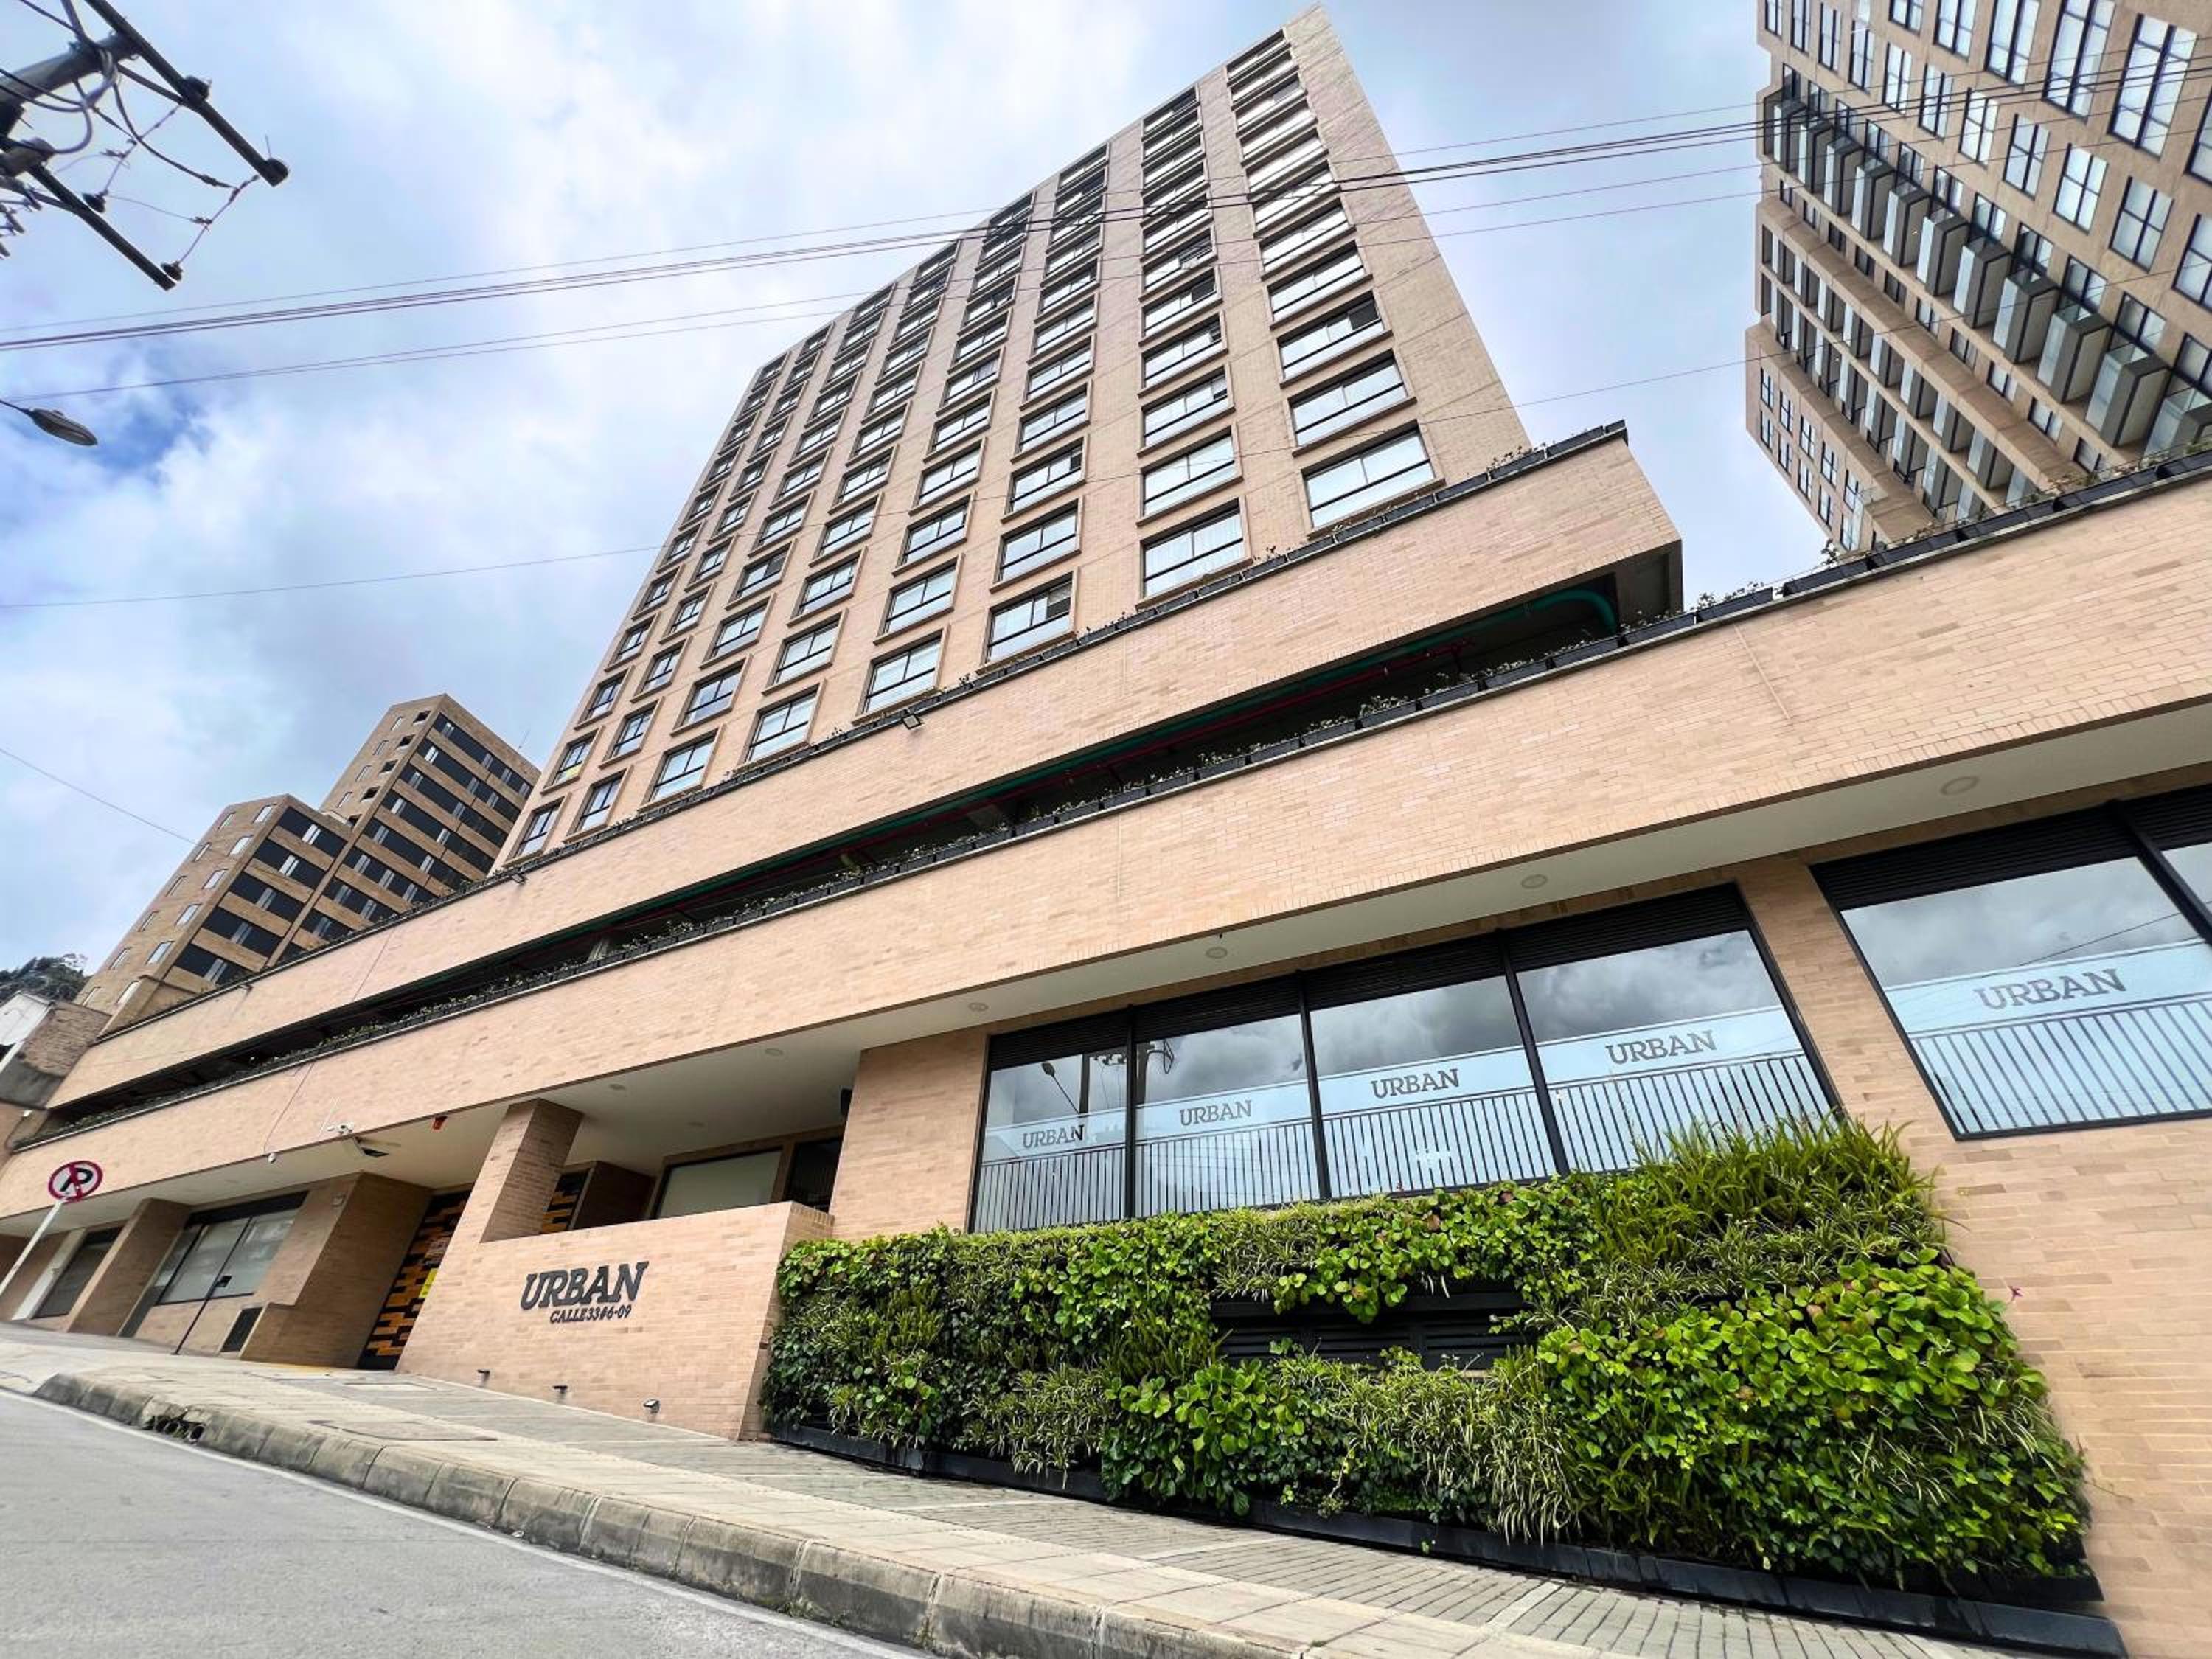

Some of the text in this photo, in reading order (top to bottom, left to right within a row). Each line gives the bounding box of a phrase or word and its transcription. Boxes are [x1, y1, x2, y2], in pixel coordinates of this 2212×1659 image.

[1974, 968, 2126, 1010] URBAN
[1605, 1030, 1717, 1065] URBAN
[1371, 1068, 1460, 1099] URBAN
[1180, 1100, 1252, 1126] URBAN
[1023, 1124, 1085, 1149] URBAN
[521, 1261, 649, 1310] URBAN
